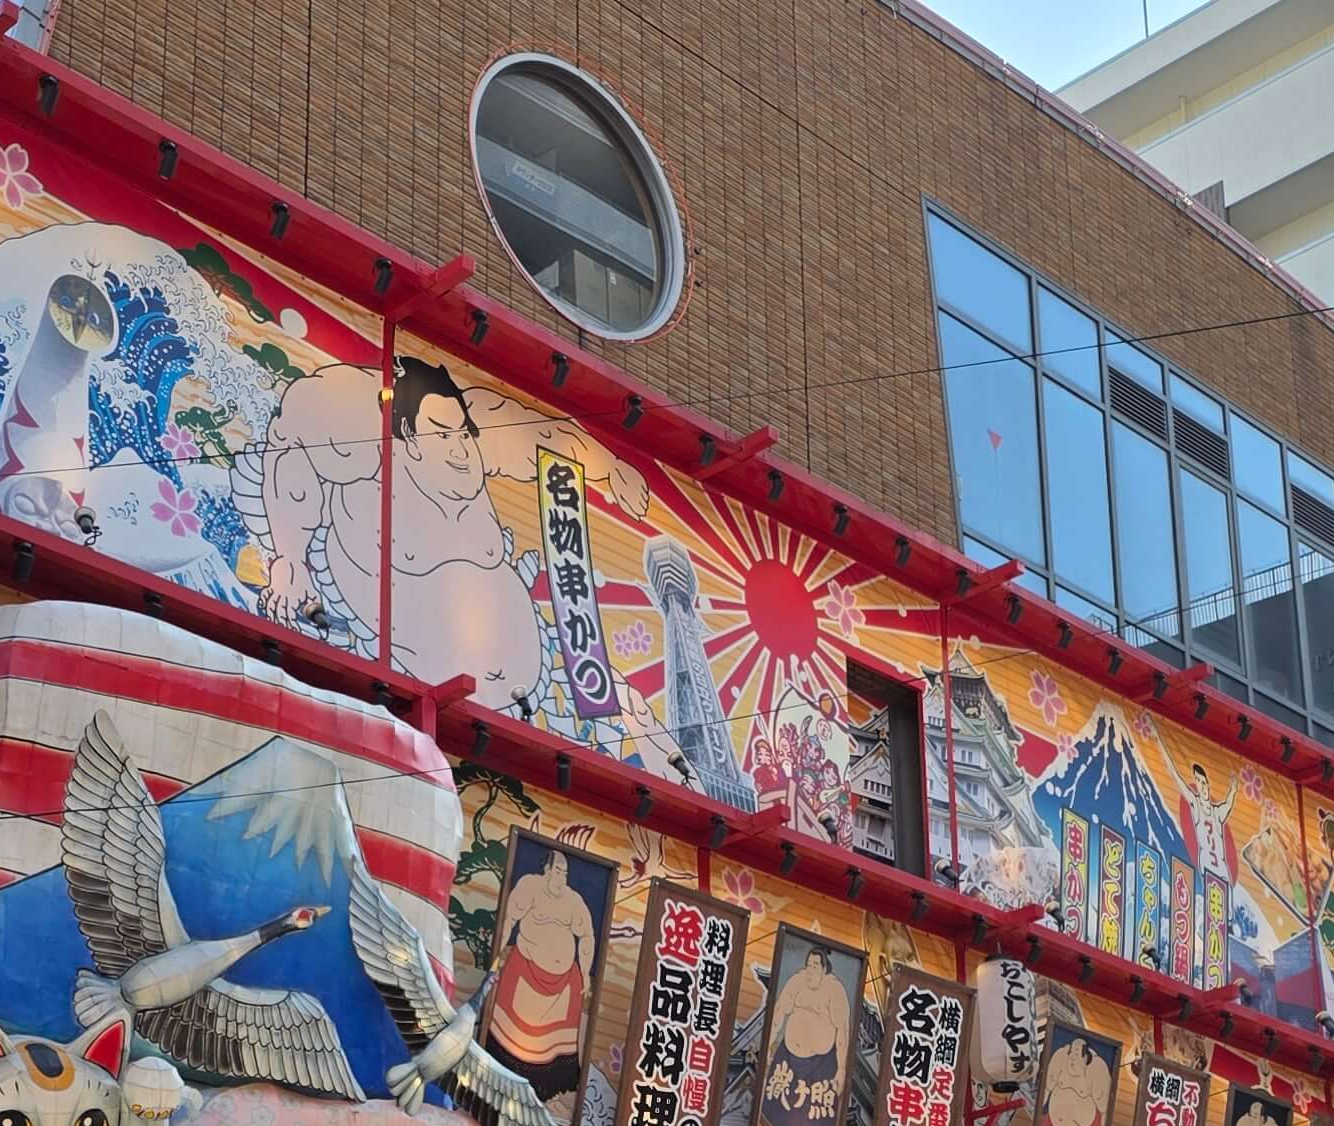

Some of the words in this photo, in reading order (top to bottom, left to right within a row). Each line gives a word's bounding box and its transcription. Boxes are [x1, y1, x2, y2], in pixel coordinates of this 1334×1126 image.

[546, 463, 607, 701] 名物串かつ
[1067, 820, 1084, 942] 串かつ
[1103, 839, 1124, 958] どて焼
[1172, 871, 1191, 984] もつ鍋
[1208, 882, 1224, 990] 串かつ
[999, 959, 1033, 1074] おこしやす
[1149, 1071, 1182, 1102] 横綱
